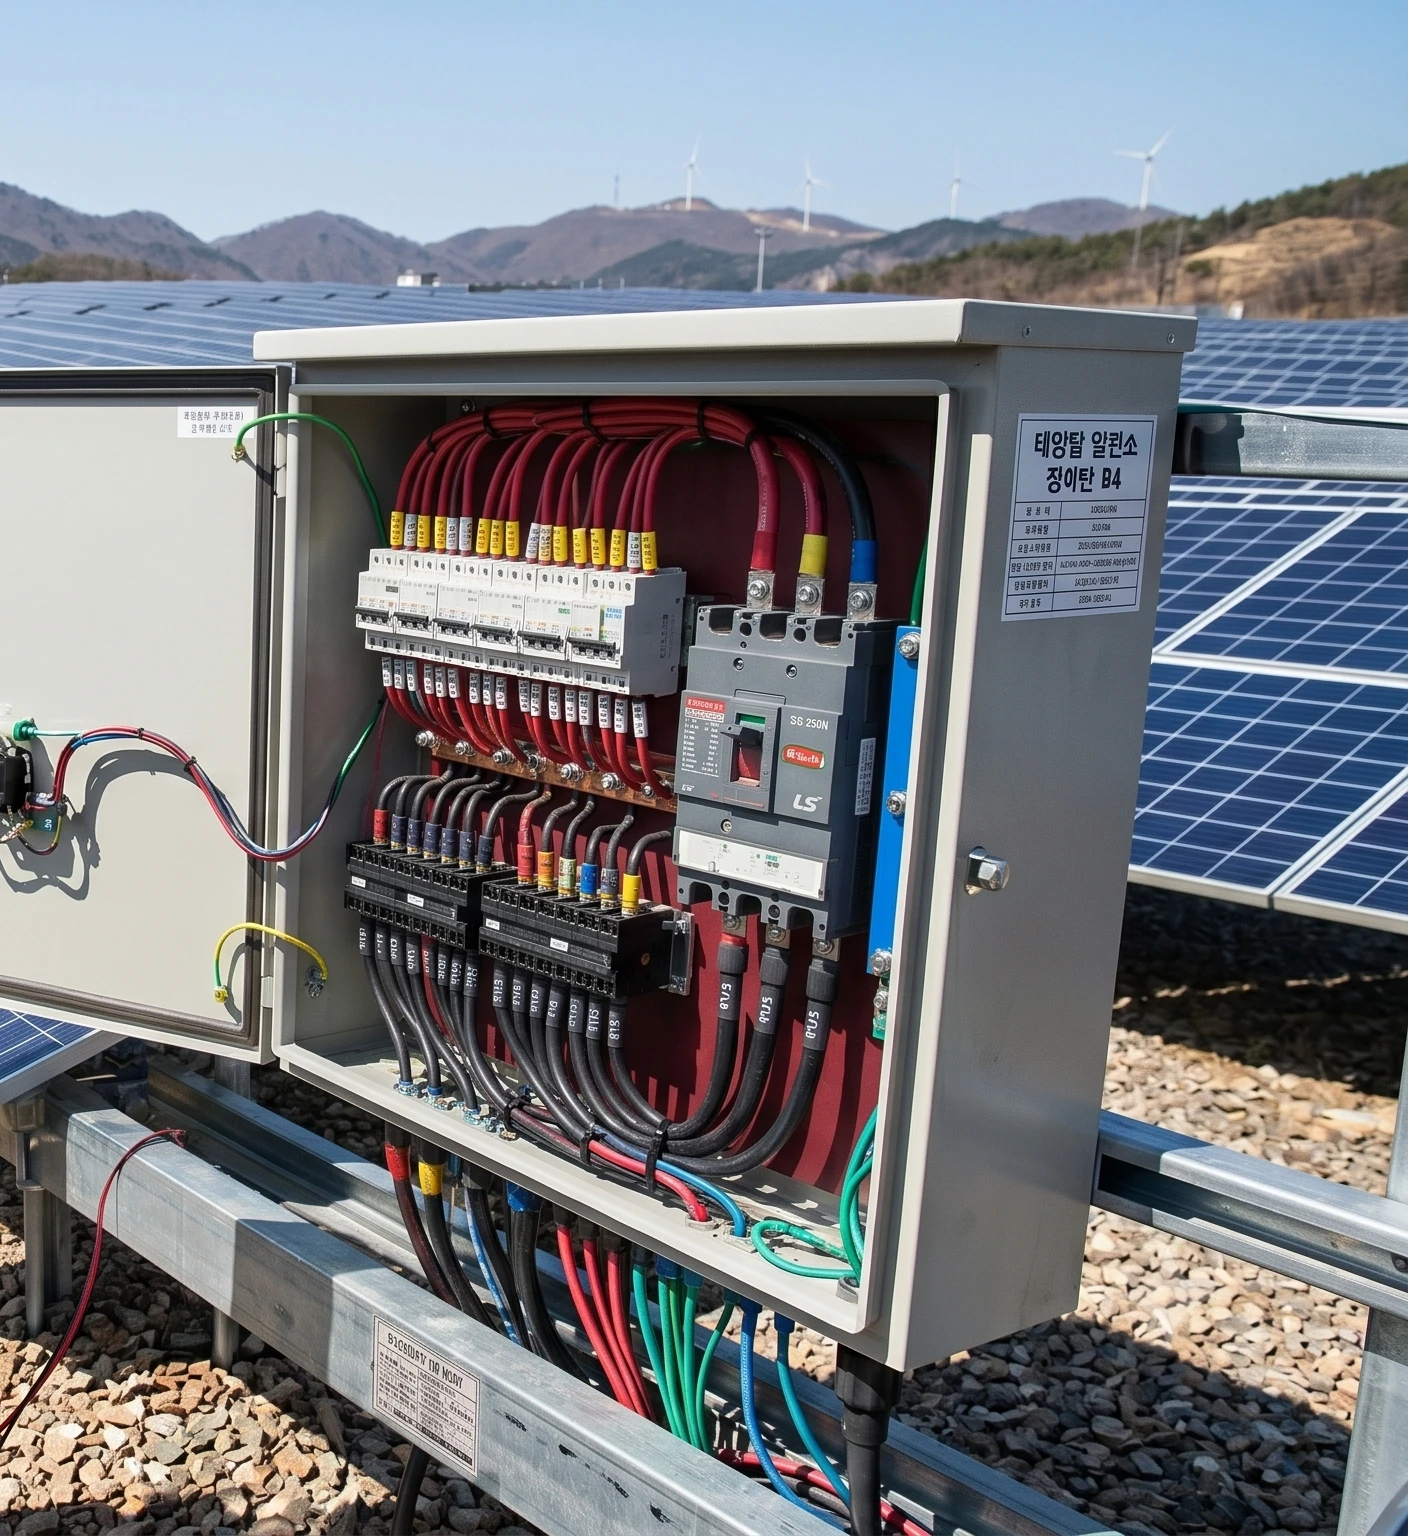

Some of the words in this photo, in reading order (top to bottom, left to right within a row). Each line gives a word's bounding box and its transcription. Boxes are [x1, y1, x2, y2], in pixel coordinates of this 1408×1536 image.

[1101, 467, 1122, 490] B4
[805, 717, 829, 731] 250N
[793, 793, 821, 813] LS
